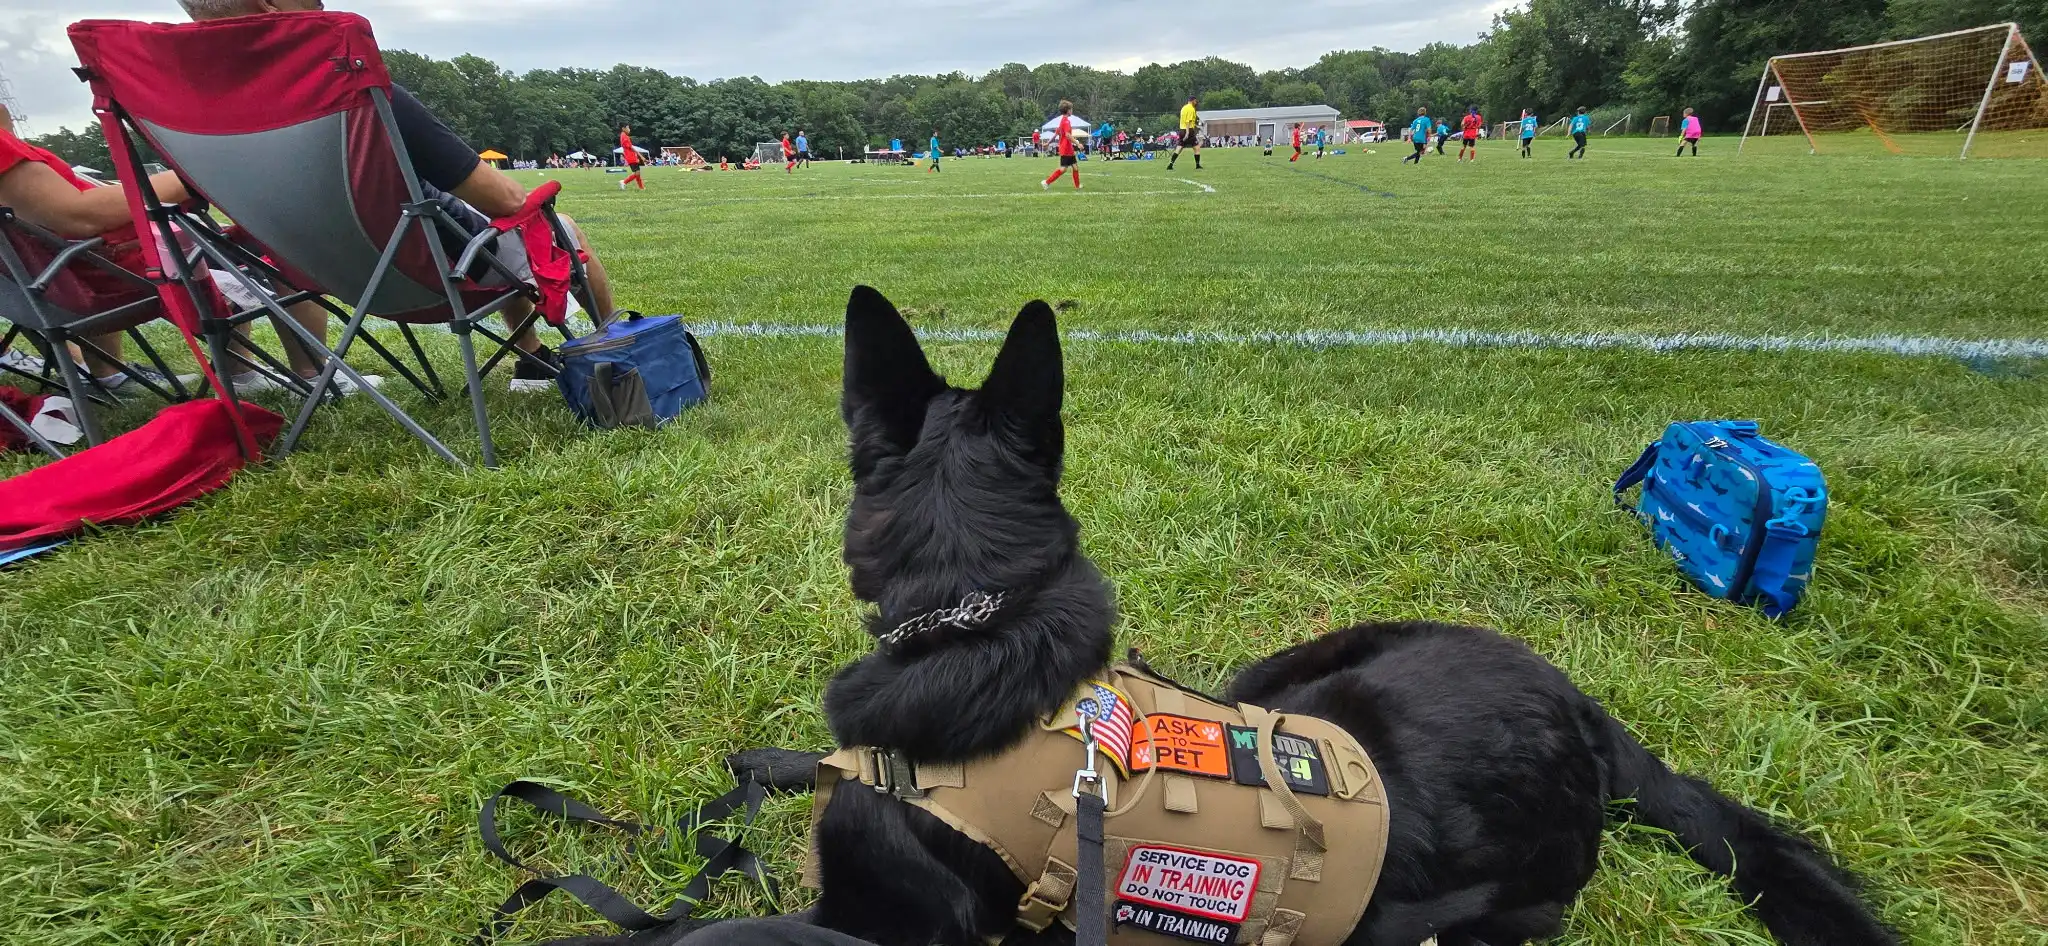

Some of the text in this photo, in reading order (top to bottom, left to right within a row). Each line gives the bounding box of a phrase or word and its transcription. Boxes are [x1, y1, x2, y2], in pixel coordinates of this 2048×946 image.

[1154, 718, 1200, 737] ASK
[1170, 737, 1187, 746] TO
[1156, 746, 1203, 768] PET
[1139, 850, 1250, 878] SERVICE DOG
[1131, 864, 1245, 901] IN TRAINING
[1126, 883, 1238, 915] DO NOT TOUCH
[1135, 909, 1229, 943] IN TRAINING
